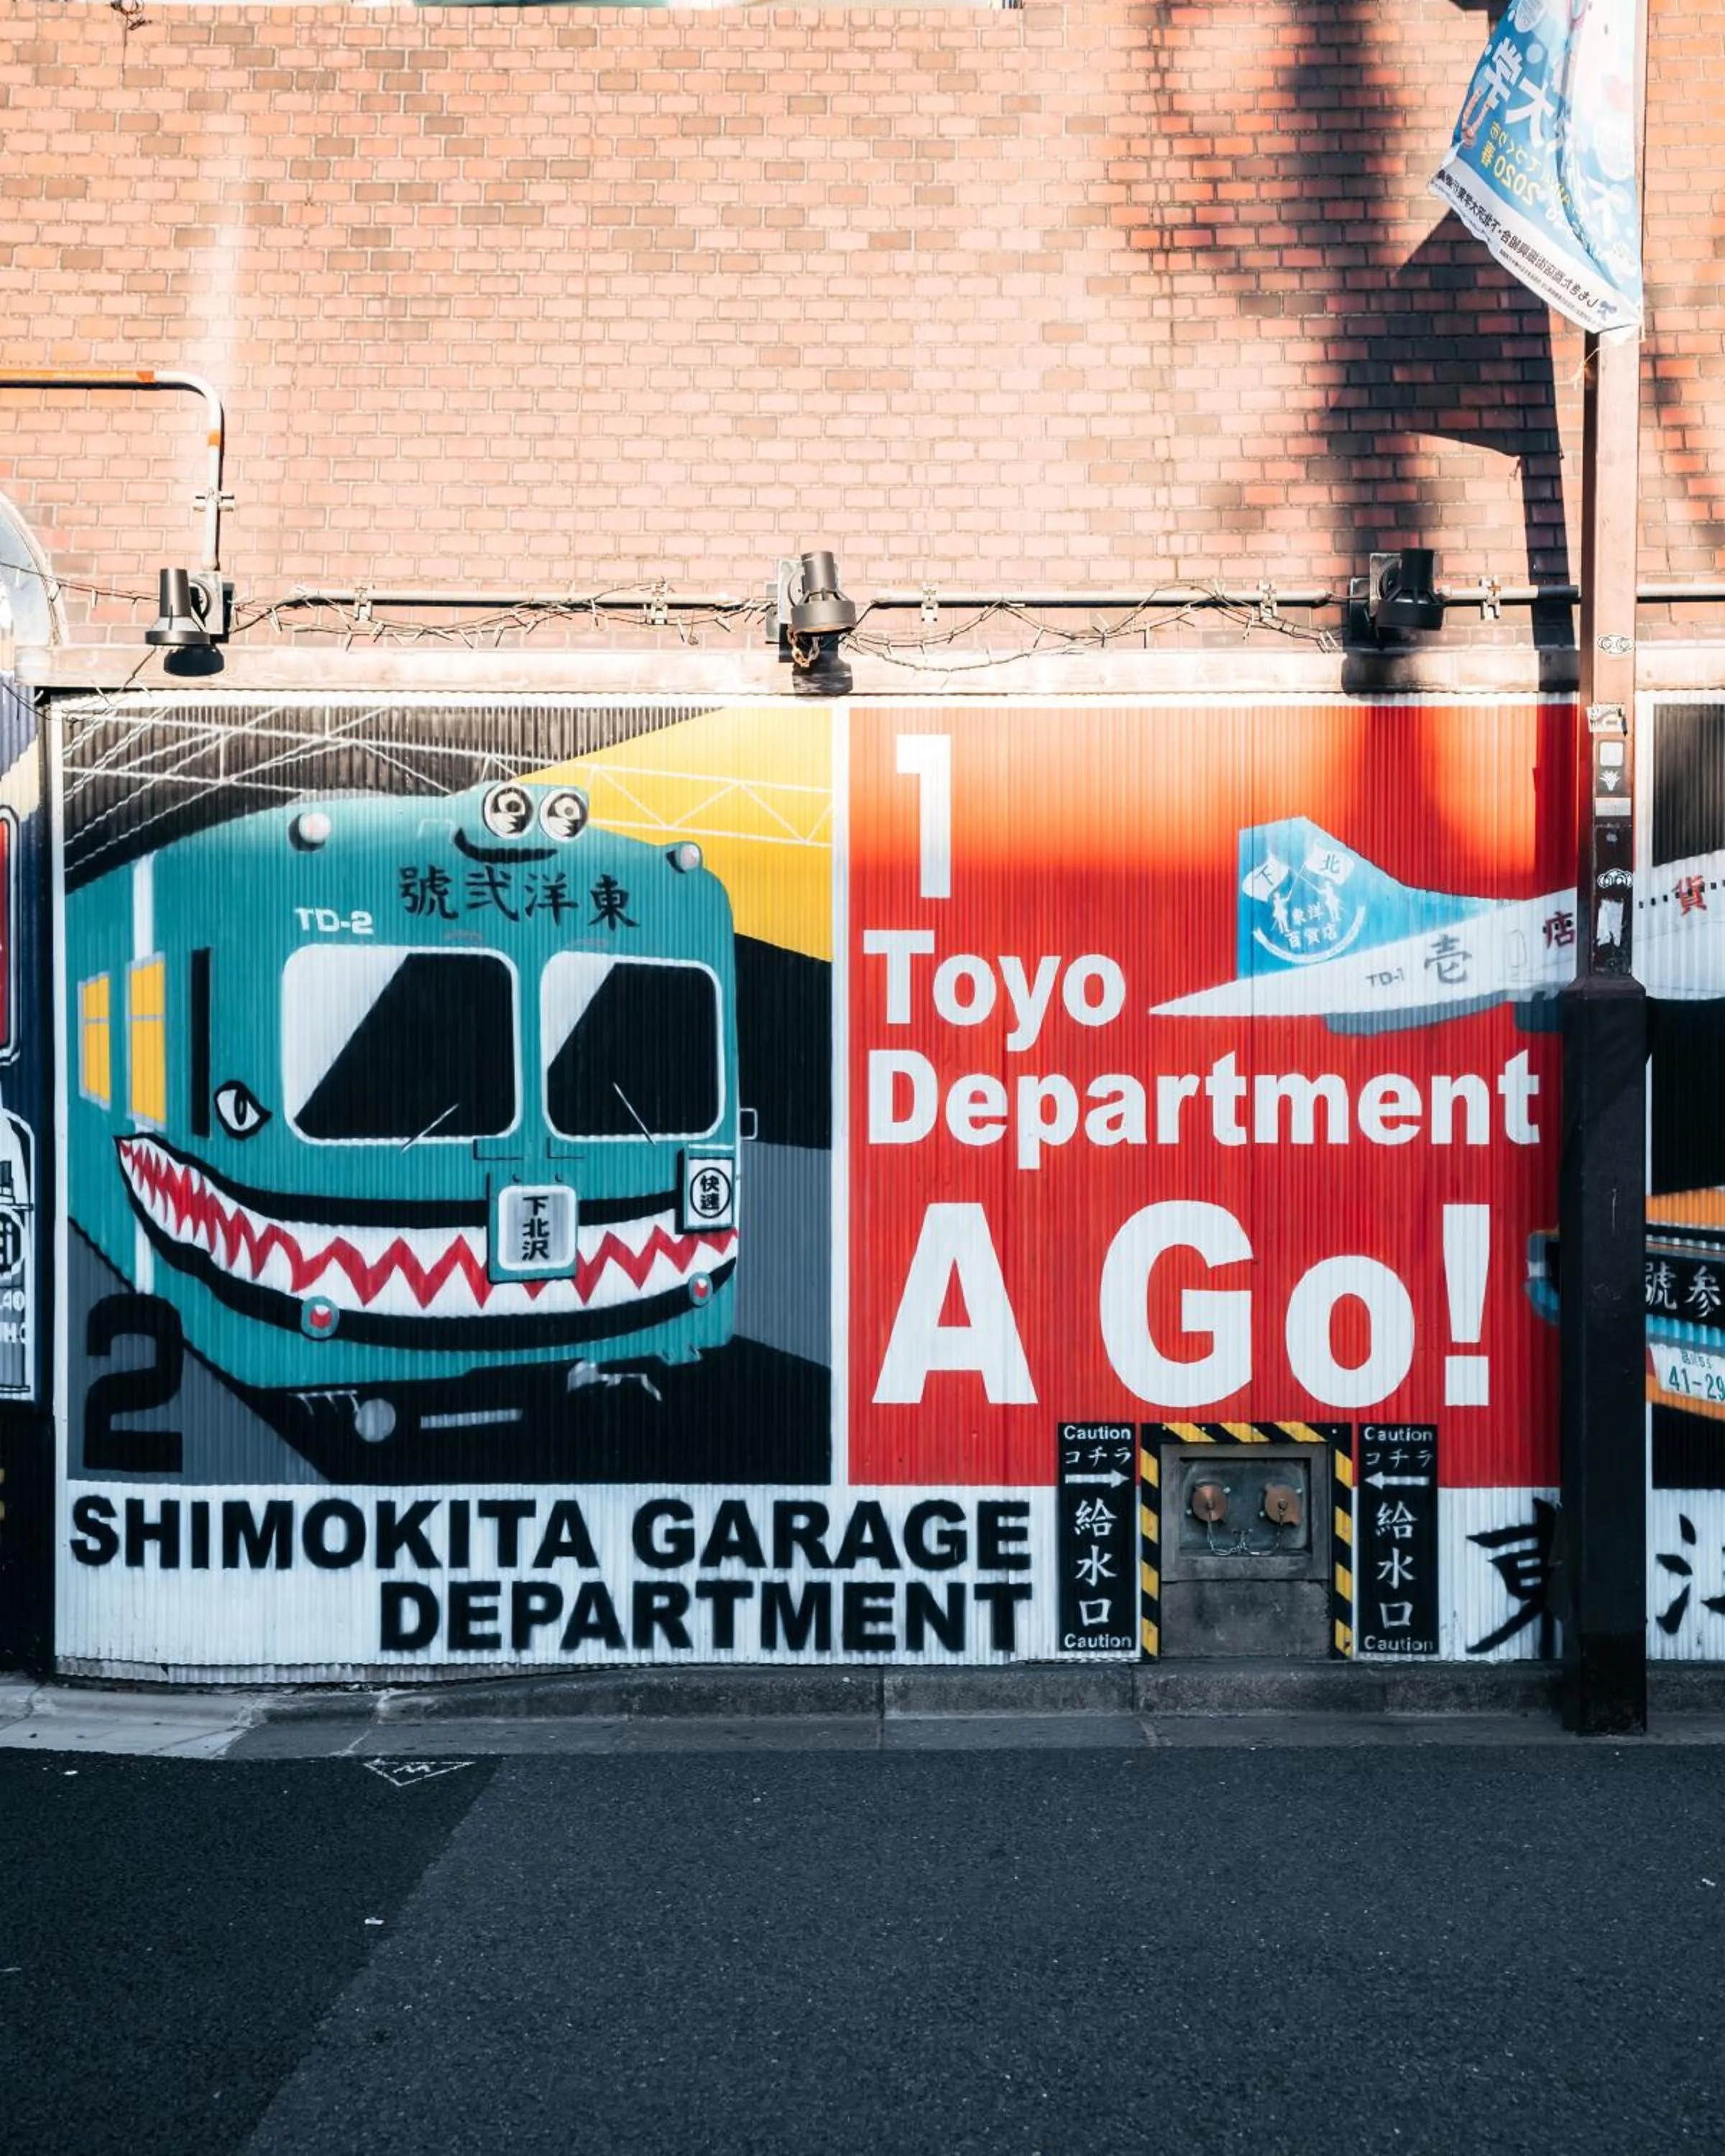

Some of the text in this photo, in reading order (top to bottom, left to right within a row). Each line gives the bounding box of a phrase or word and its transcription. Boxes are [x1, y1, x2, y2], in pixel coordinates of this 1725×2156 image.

[896, 734, 951, 898] 1
[1318, 853, 1340, 875] 北
[293, 908, 374, 935] TD-2
[1542, 910, 1576, 949] 店
[863, 930, 1126, 1051] Toyo
[1366, 967, 1405, 987] TD-1
[868, 1049, 1540, 1169] Department
[522, 1195, 551, 1261] 下北沢
[872, 1199, 1491, 1408] A Go!
[82, 1293, 183, 1473] 2
[1063, 1426, 1131, 1440] Caution
[1064, 1447, 1132, 1467] コチラ
[1363, 1427, 1433, 1442] Caution
[1365, 1447, 1433, 1468] コチラ
[70, 1494, 1032, 1571] SHIMOKITA GARAGE
[1074, 1498, 1117, 1627] 給水口
[1374, 1500, 1417, 1629] 給水口
[380, 1580, 1033, 1652] DEPARTMENT
[1064, 1634, 1132, 1649] Caution
[1363, 1635, 1433, 1651] Caution
